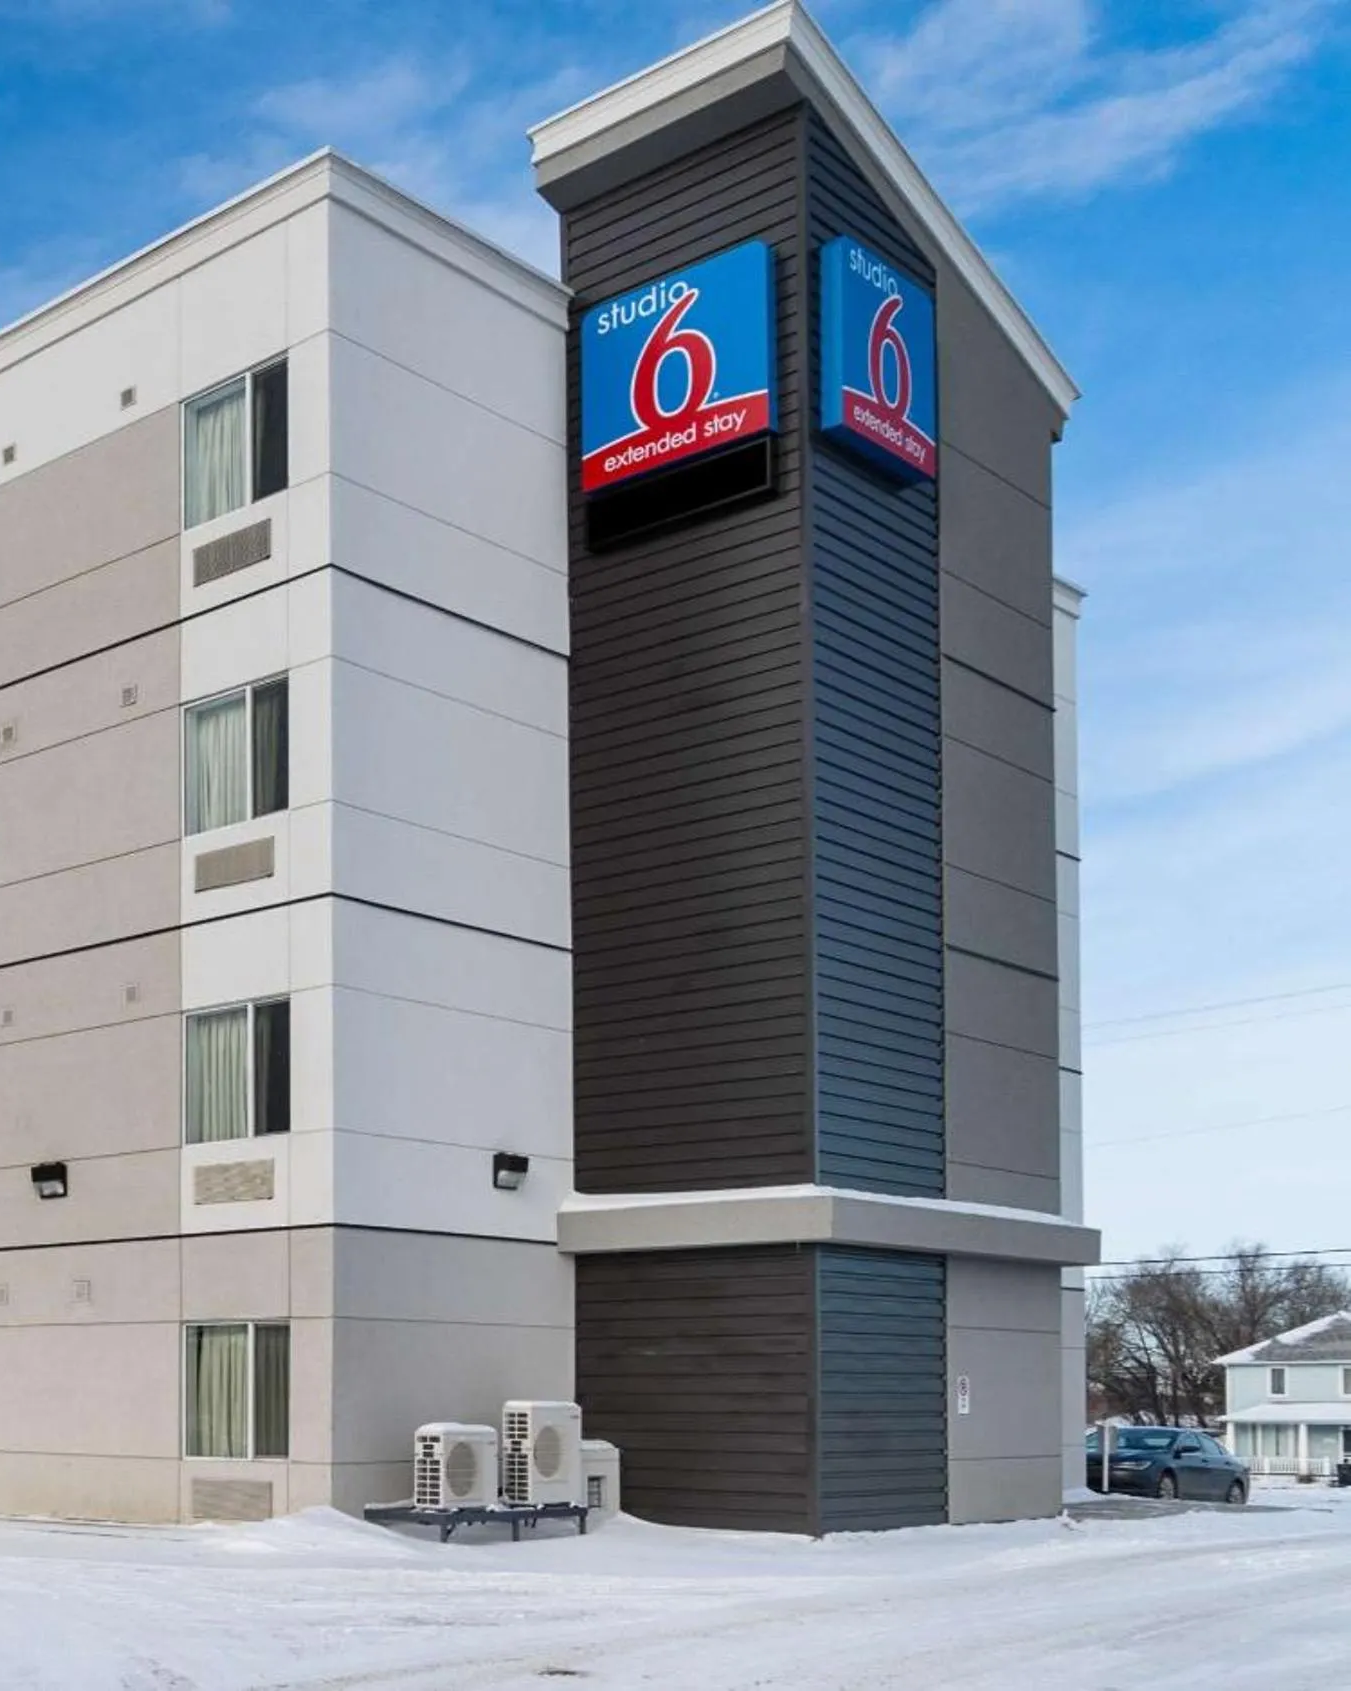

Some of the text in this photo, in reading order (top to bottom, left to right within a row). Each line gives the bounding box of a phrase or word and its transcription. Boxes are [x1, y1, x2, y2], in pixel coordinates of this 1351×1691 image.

[849, 249, 899, 296] studio
[596, 280, 690, 335] studio
[630, 287, 717, 428] 6
[868, 295, 912, 418] 6
[603, 408, 747, 473] extended stay
[853, 404, 927, 464] extended stay
